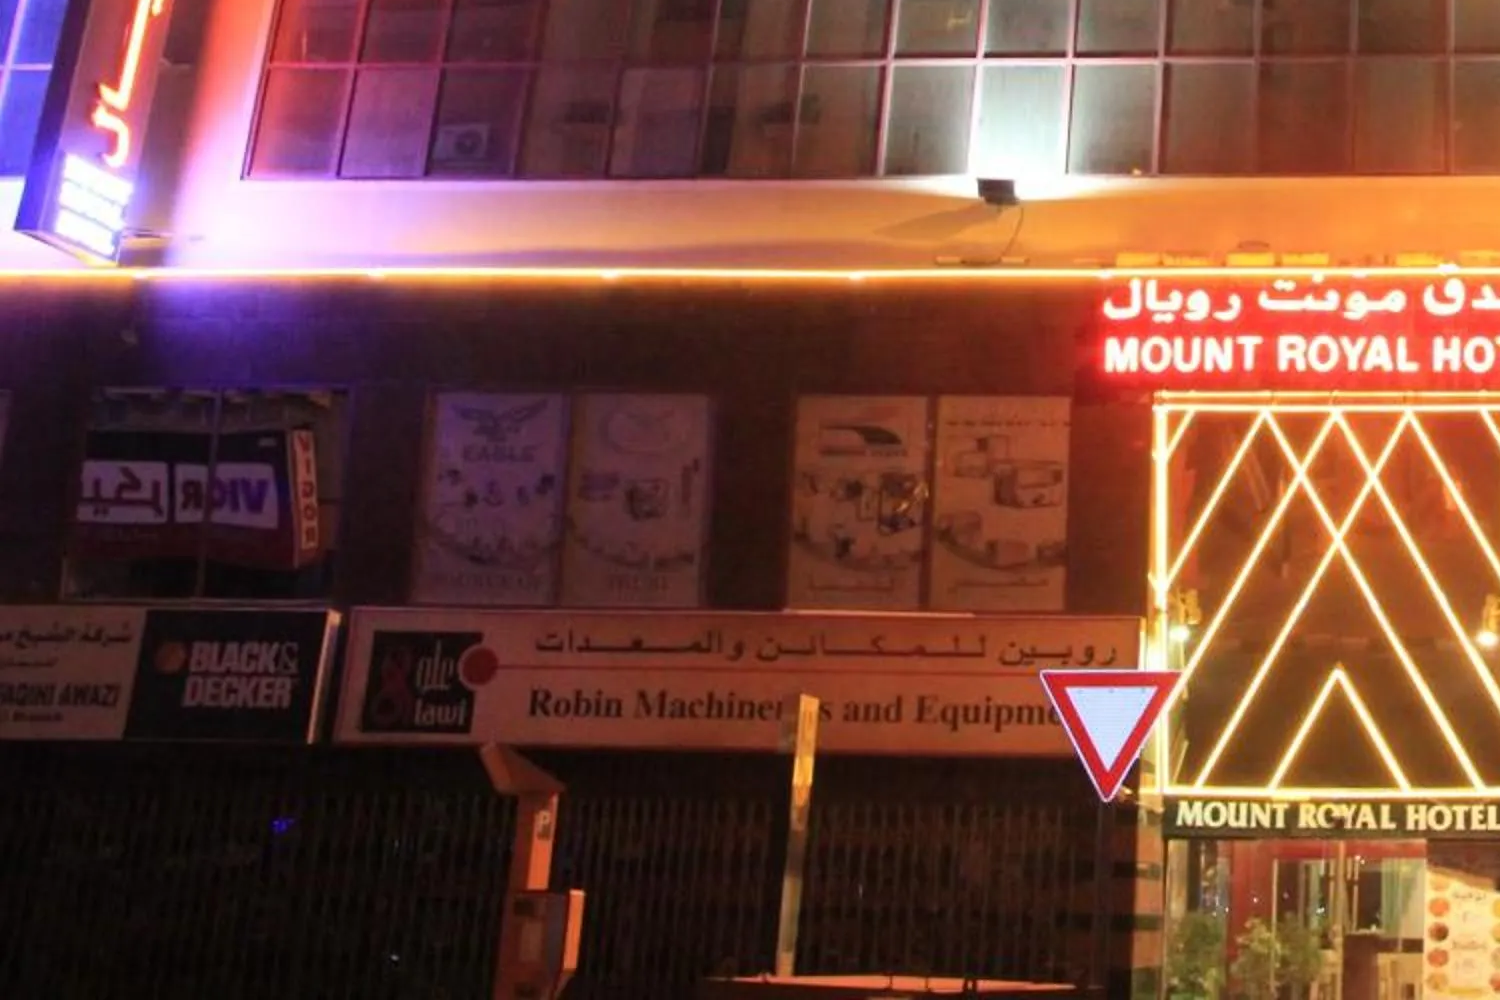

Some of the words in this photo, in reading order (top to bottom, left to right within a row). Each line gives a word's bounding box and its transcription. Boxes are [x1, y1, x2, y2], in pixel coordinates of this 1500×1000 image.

[1103, 278, 1242, 322] رويال
[1104, 336, 1262, 373] MOUNT
[1277, 336, 1419, 373] ROYAL
[181, 677, 293, 708] DECKER
[528, 689, 623, 719] Robin
[843, 698, 902, 723] and
[1176, 800, 1290, 829] MOUNT
[1298, 801, 1396, 830] ROYAL
